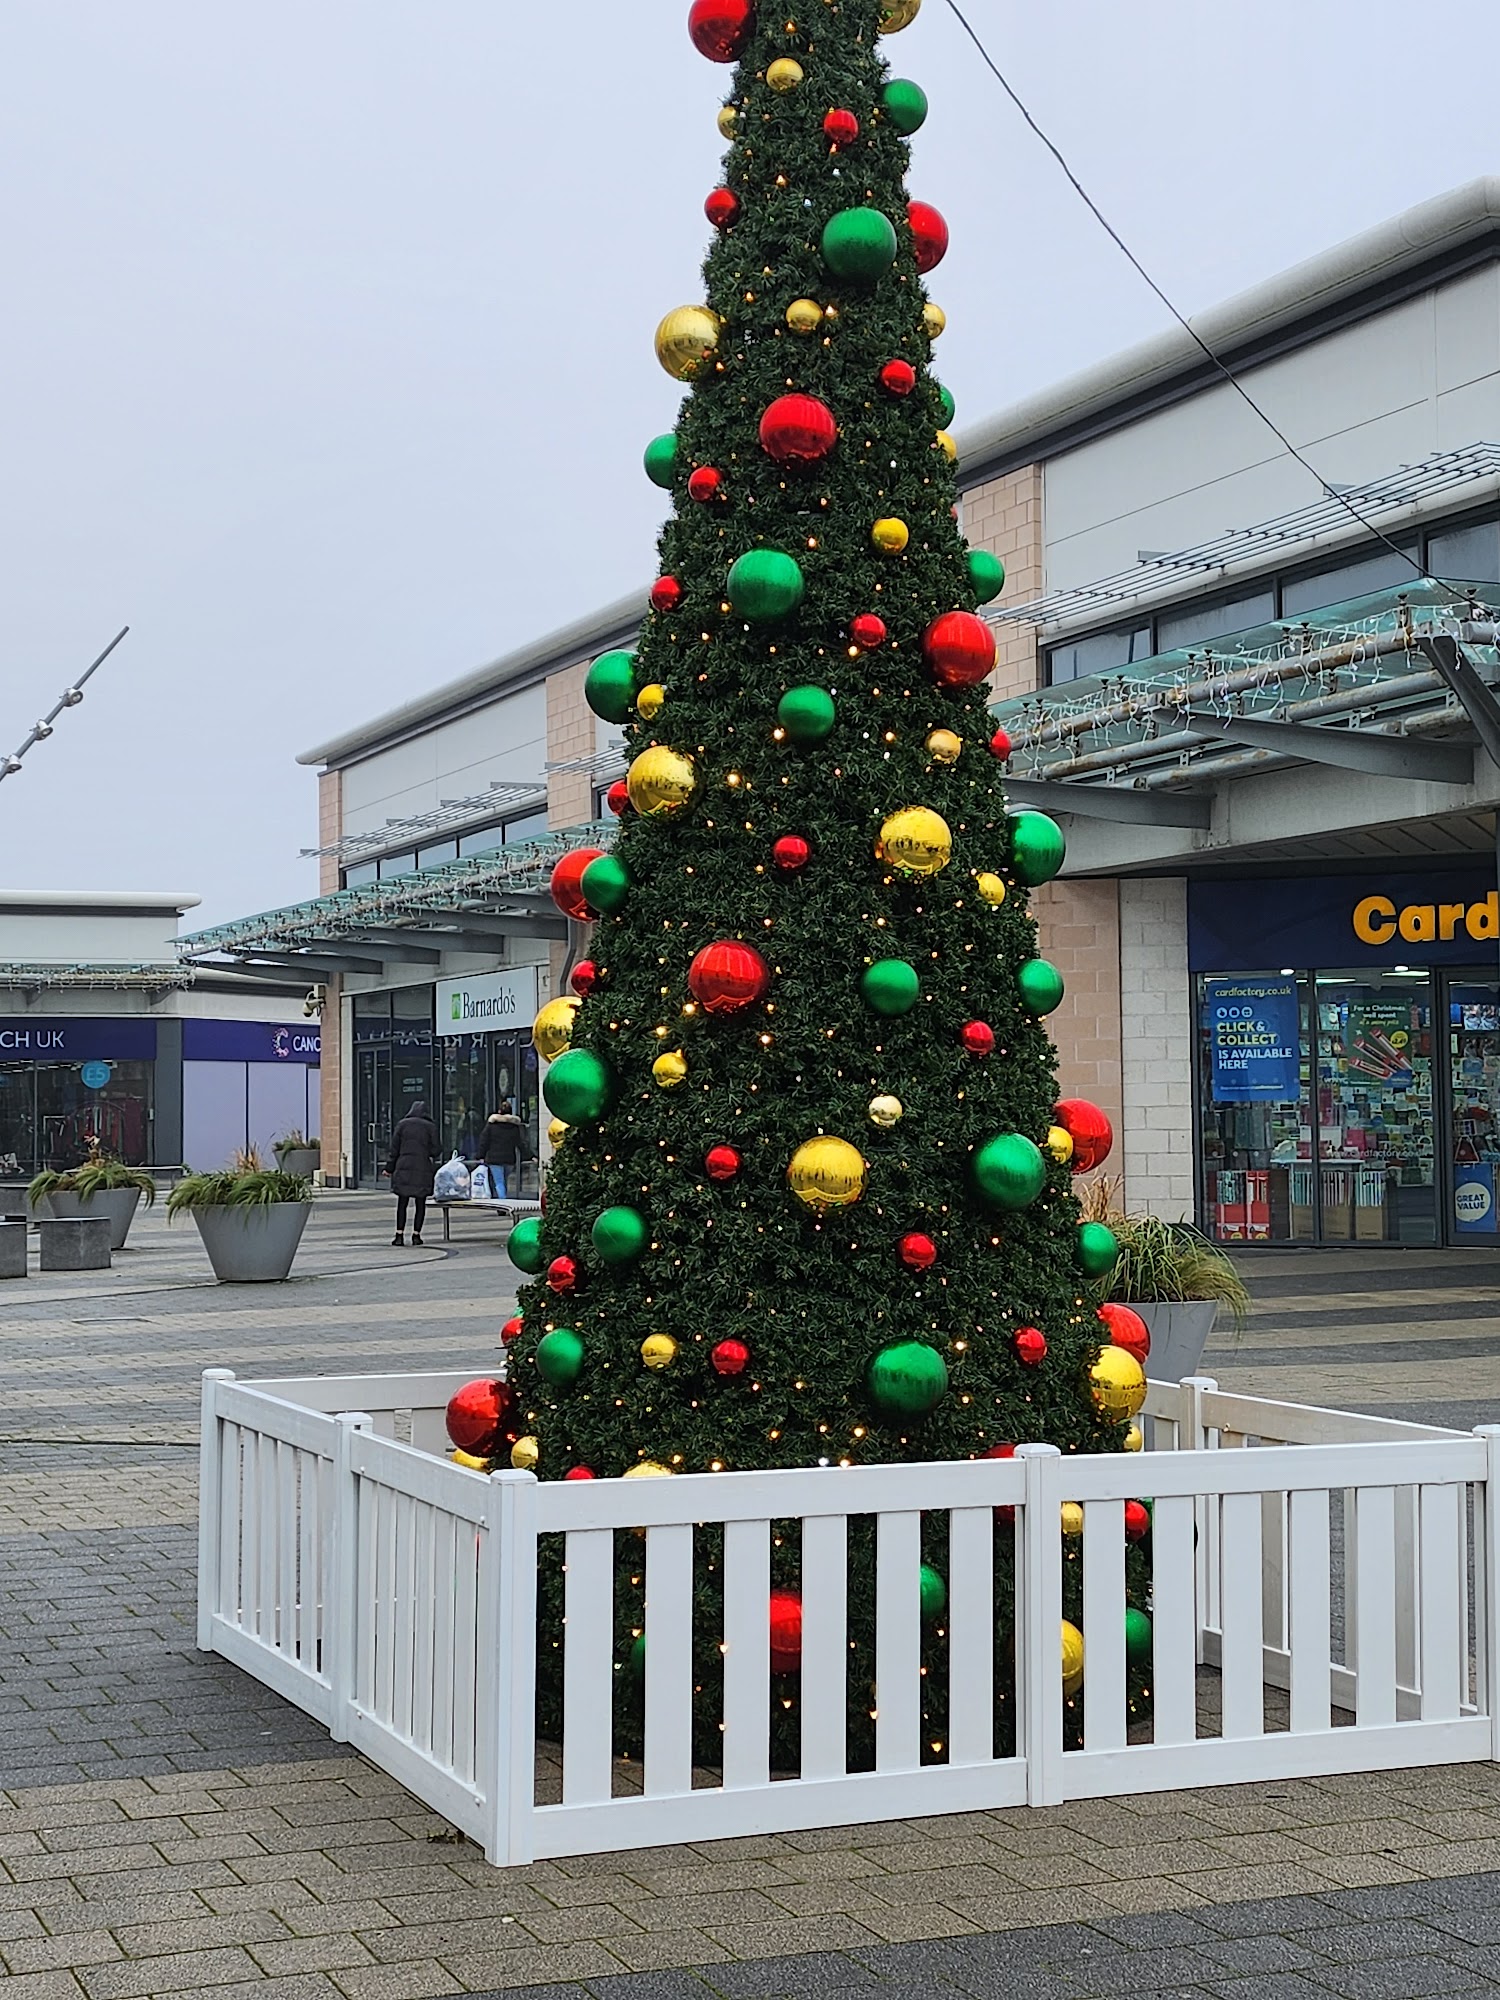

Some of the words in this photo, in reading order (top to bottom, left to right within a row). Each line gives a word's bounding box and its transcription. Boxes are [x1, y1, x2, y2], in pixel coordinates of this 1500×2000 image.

[1353, 891, 1499, 945] Card
[1215, 987, 1292, 997] cardfactory.co.uk
[463, 988, 516, 1019] Barnardo's
[1216, 1021, 1255, 1032] CLICK
[1256, 1021, 1265, 1031] &
[36, 1031, 65, 1048] UK
[1217, 1034, 1277, 1045] COLLECT
[1218, 1050, 1229, 1059] IS
[1231, 1048, 1293, 1058] AVAILABLE
[1218, 1060, 1248, 1069] HERE
[1456, 1193, 1485, 1202] GREAT
[1457, 1202, 1485, 1210] VALUE
